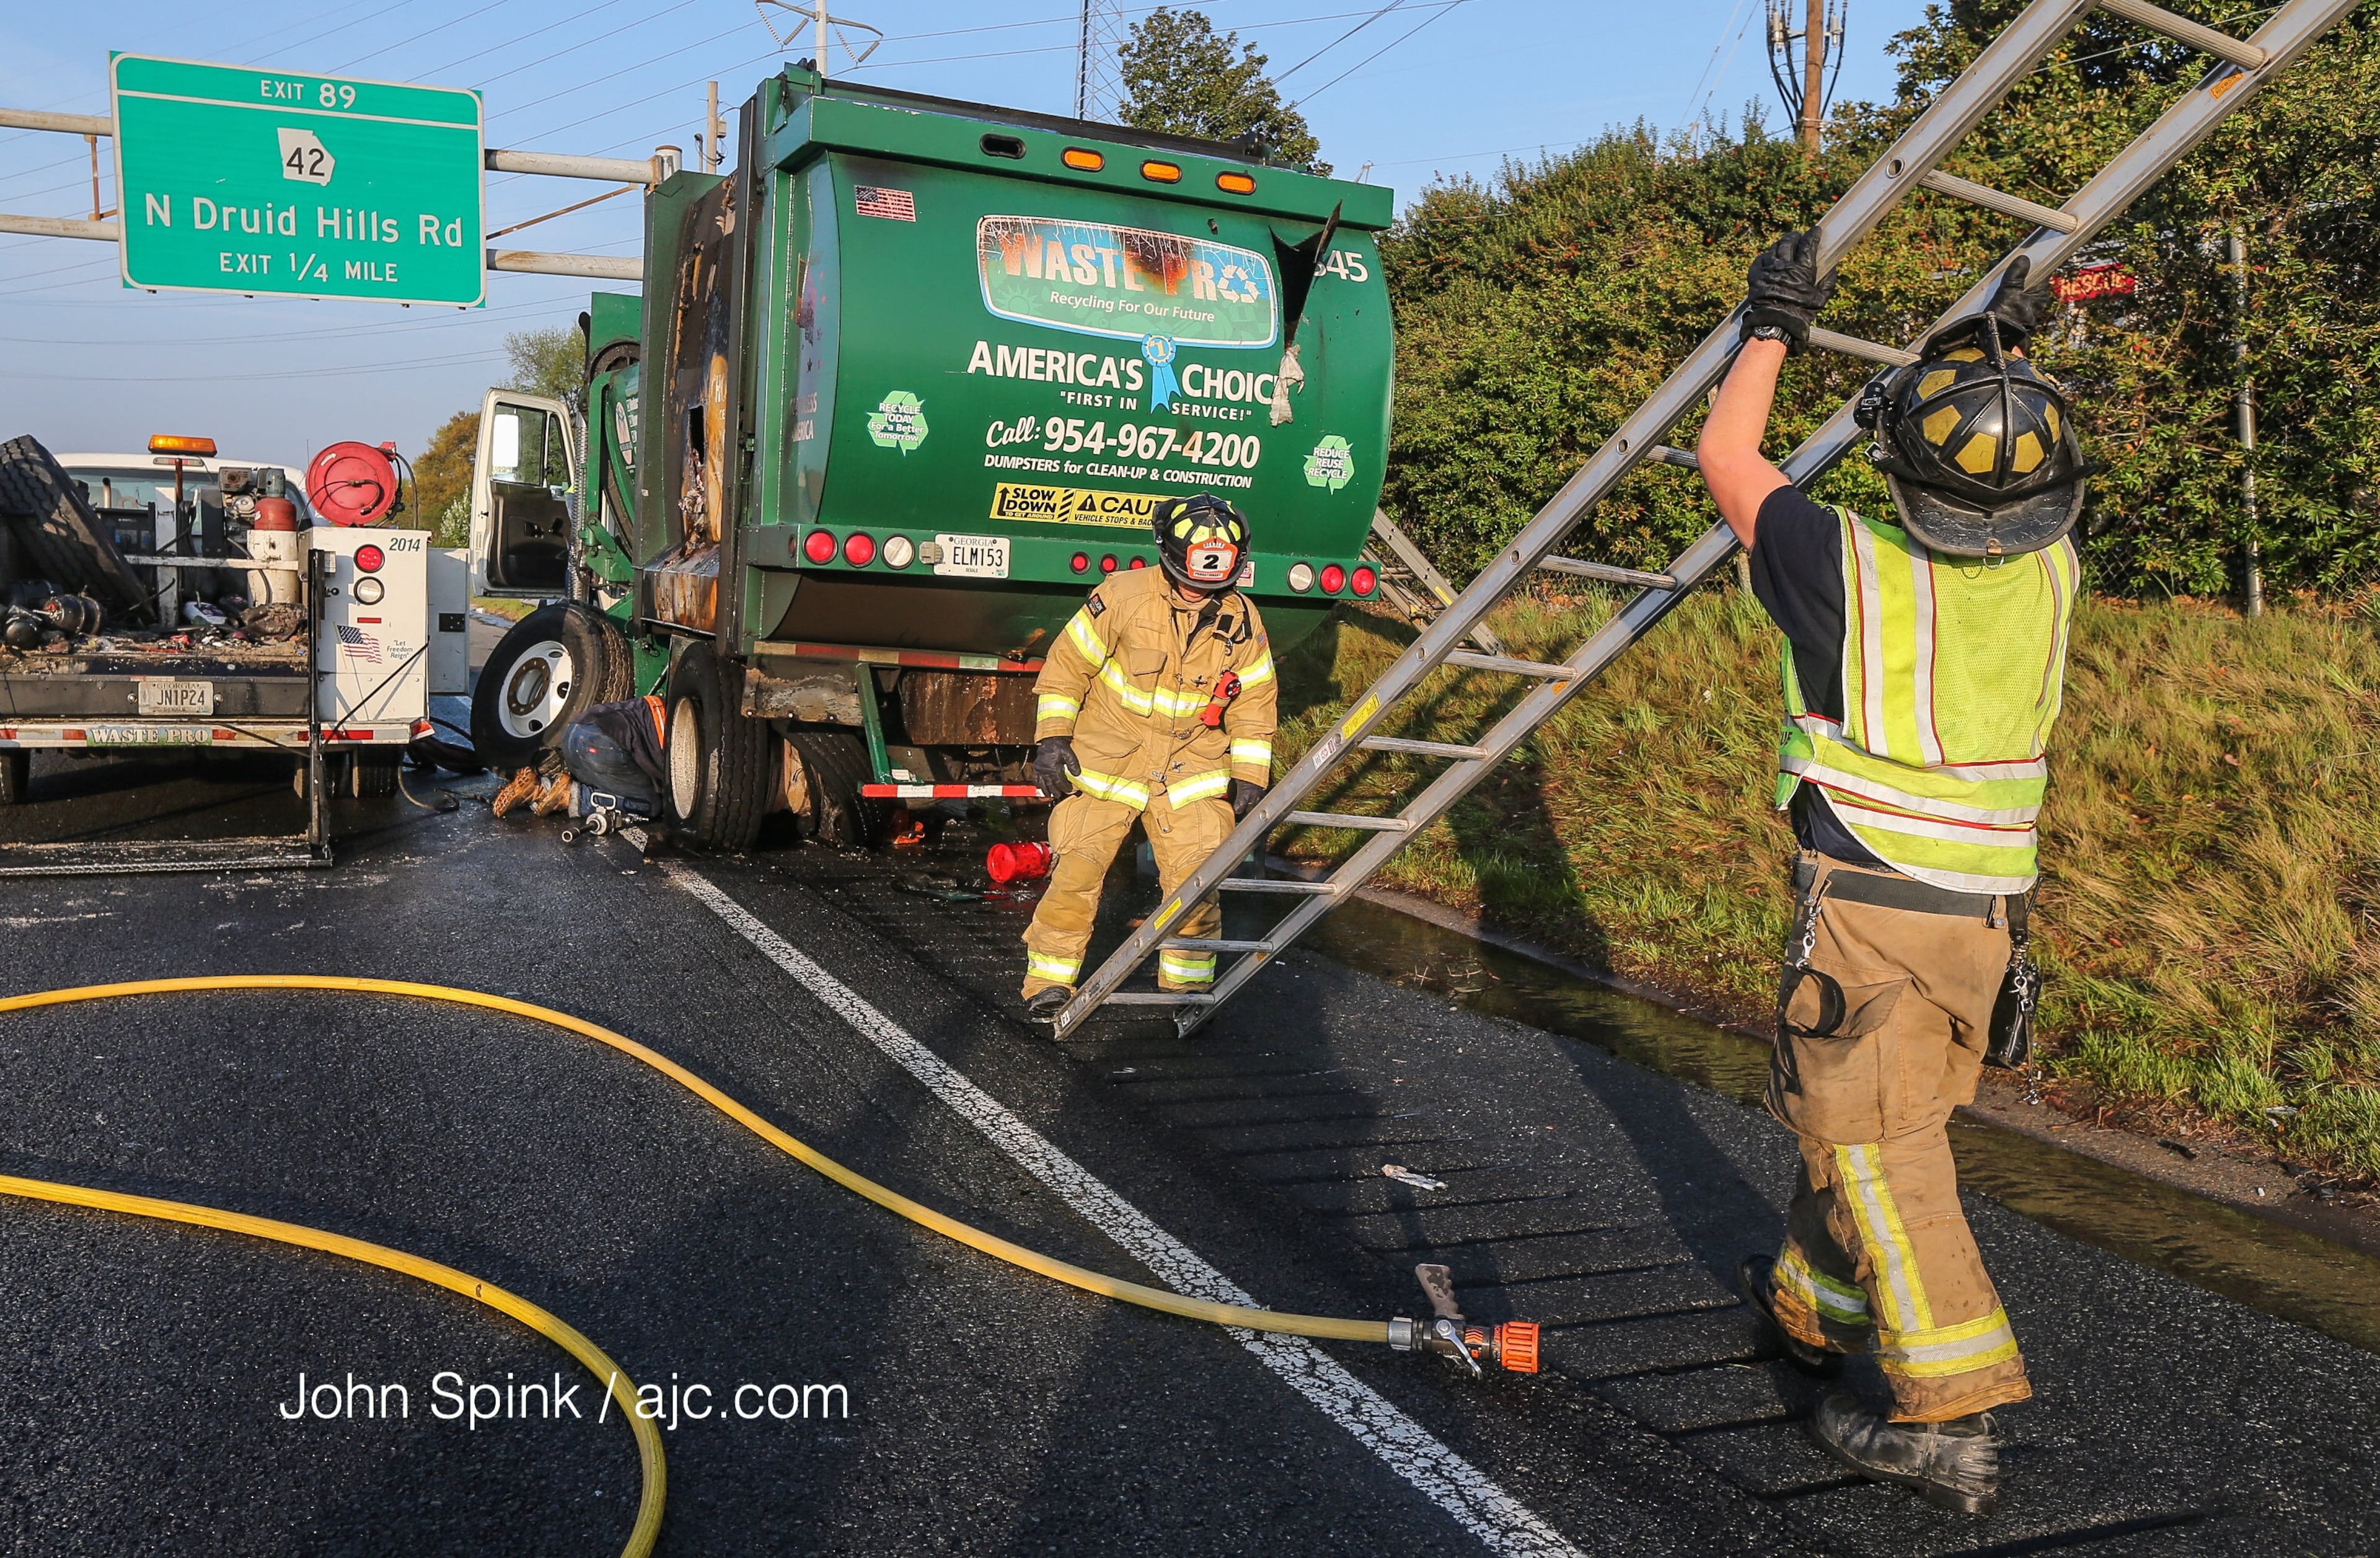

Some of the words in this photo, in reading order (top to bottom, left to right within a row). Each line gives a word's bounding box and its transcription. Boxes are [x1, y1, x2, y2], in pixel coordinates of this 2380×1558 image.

[260, 80, 304, 101] EXIT
[319, 82, 356, 109] 89
[286, 147, 325, 177] 42
[145, 193, 171, 227] N
[193, 197, 297, 237] Druid
[317, 206, 400, 244] Hills
[418, 214, 462, 248] Rd
[219, 252, 271, 275] EXIT
[289, 252, 329, 283] 1/4
[345, 260, 399, 283] MILE
[998, 232, 1145, 292] WASTE
[1049, 290, 1114, 314] Recycling
[1118, 298, 1140, 314] For
[1144, 302, 1170, 320] Our
[1173, 306, 1215, 322] Future
[967, 340, 1144, 391] AMERICA'S
[1181, 363, 1279, 405] CHOIC
[879, 402, 921, 414] RECYCLE
[1060, 391, 1113, 409] "FIRST
[1119, 396, 1138, 410] IN
[1171, 402, 1253, 422] SERVICE!"
[883, 412, 914, 423] TODAY
[871, 422, 886, 430] For
[896, 423, 924, 433] Better
[875, 430, 919, 441] Tomorrow
[985, 415, 1041, 448] Call:
[1043, 416, 1261, 469] 954-967-4200
[1313, 446, 1350, 459] REDUCE
[1316, 458, 1344, 469] REUSE
[984, 454, 1060, 473] DUMPSTERS
[1064, 459, 1083, 475] for
[1085, 462, 1147, 480] CLEAN-UP
[1150, 468, 1160, 482] &
[1163, 469, 1253, 489] CONSTRUCTION
[1308, 467, 1348, 479] RECYCLE
[1012, 487, 1056, 501] SLOW
[1005, 499, 1057, 513] DOWN
[1101, 497, 1161, 516] CAU
[1074, 514, 1104, 523] VEHICLE
[1105, 516, 1128, 525] STOPS
[389, 538, 421, 552] 2014
[954, 536, 993, 547] GEORGIA
[953, 547, 1003, 567] ELM153
[1202, 554, 1219, 569] 2
[157, 689, 205, 706] JN1P24
[90, 728, 159, 743] WASTE
[165, 728, 209, 743] PRO
